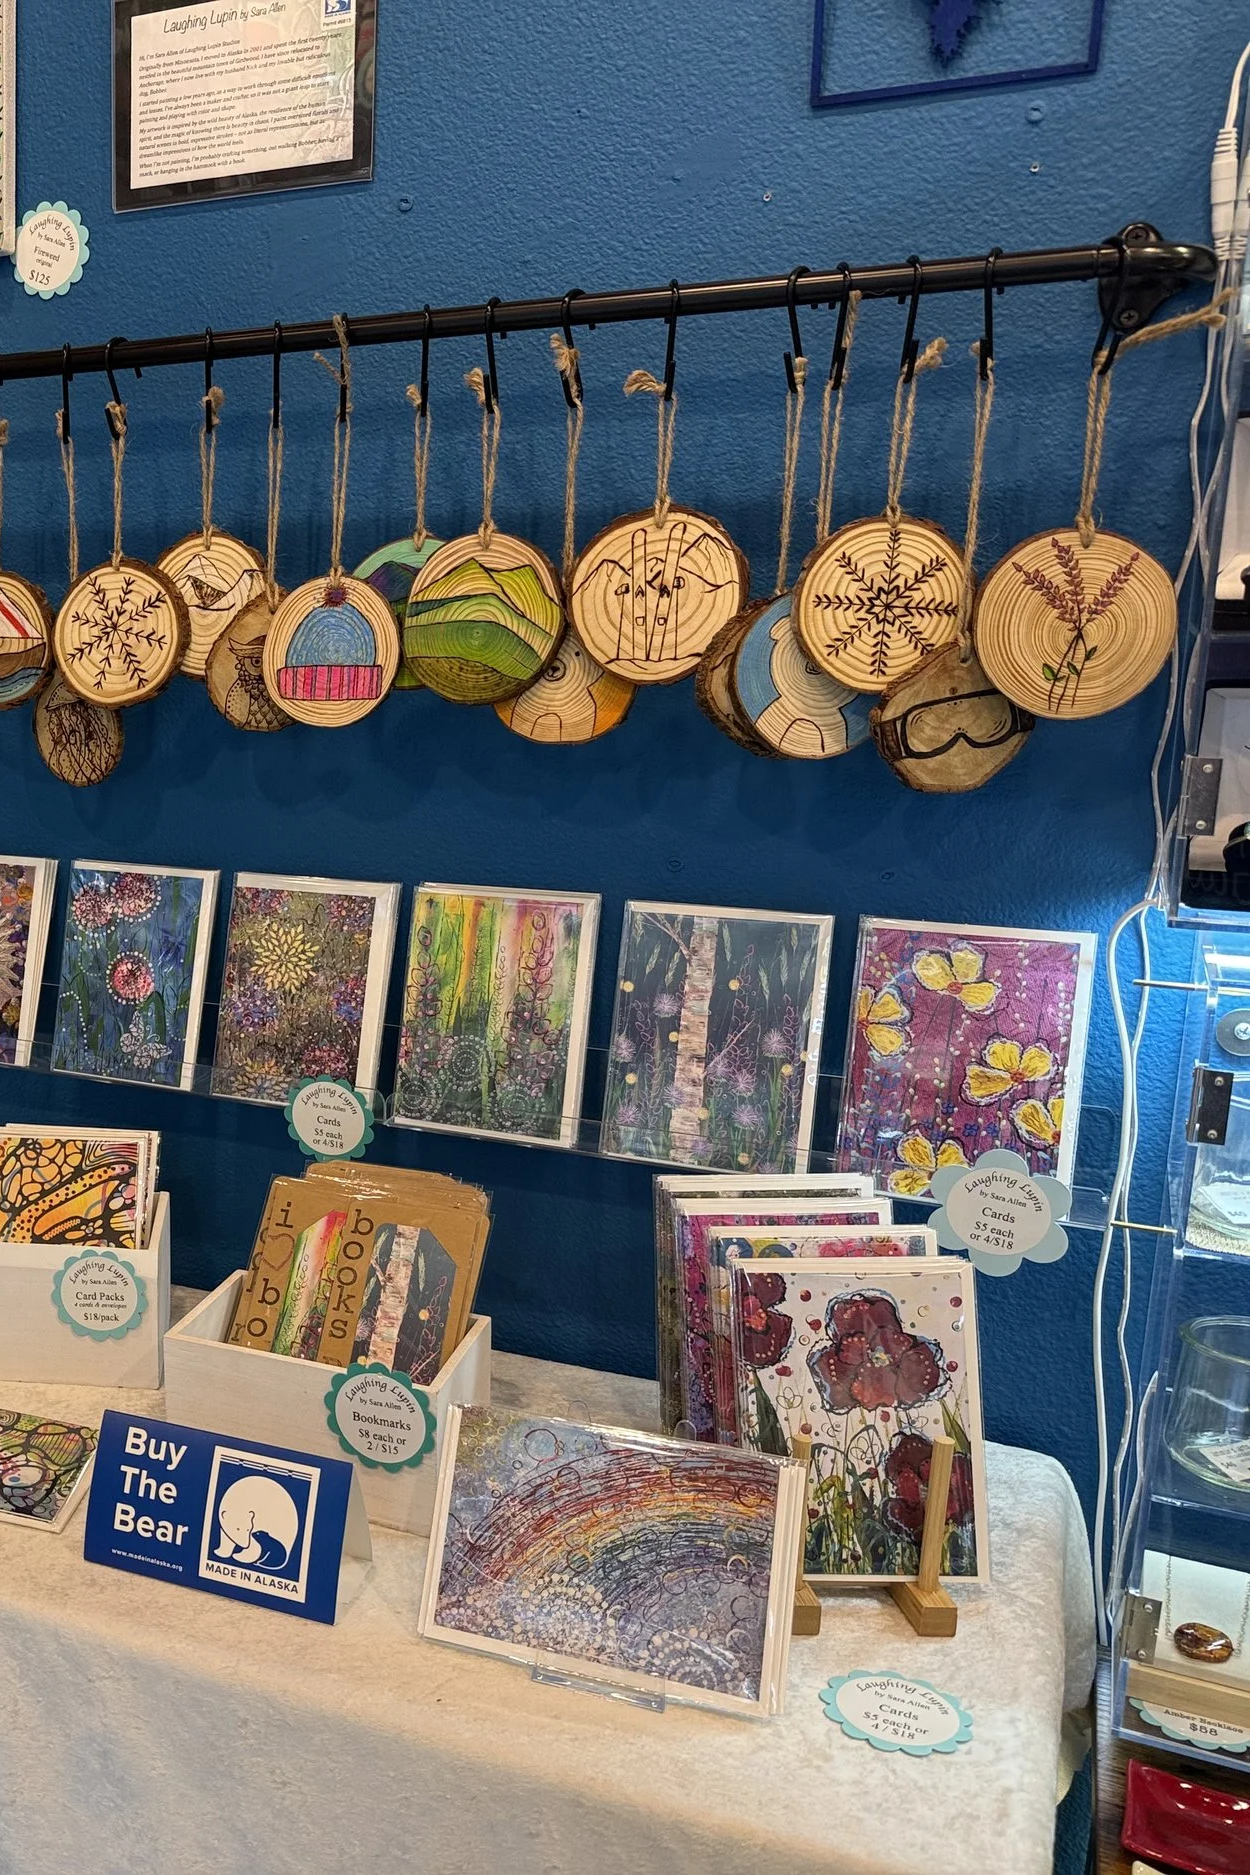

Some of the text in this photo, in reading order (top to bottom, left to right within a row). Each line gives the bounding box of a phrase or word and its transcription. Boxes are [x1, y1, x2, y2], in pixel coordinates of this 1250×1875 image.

[164, 3, 286, 34] Laughing Lupin by Sara Allen
[185, 45, 206, 53] Laughing
[30, 214, 74, 250] Laughing Lupin
[44, 234, 53, 242] Sara
[34, 246, 60, 261] Fireweed
[29, 270, 50, 285] $125
[301, 1084, 357, 1114] Laughing Lupin
[317, 1116, 340, 1127] Cards
[315, 1128, 323, 1136] $5
[322, 1139, 344, 1149] 4/$18
[964, 1171, 1042, 1212] Laughing Lupin
[980, 1190, 1027, 1207] by Sara Allen
[982, 1207, 1015, 1224] Cards
[974, 1221, 1014, 1238] $5 each
[970, 1232, 1013, 1250] or 4/$18
[69, 1261, 129, 1286] Laughing Lupin
[76, 1292, 124, 1301] Card Packs
[84, 1313, 119, 1322] $18/pack
[346, 1376, 415, 1413] Laughing Lupin
[359, 1397, 401, 1410] by Sara Allen
[353, 1411, 411, 1431] Bookmarks
[359, 1429, 406, 1445] $8 each or
[124, 1426, 187, 1471] Buy
[367, 1442, 372, 1450] 2
[382, 1445, 398, 1454] $15
[120, 1465, 177, 1504] The
[113, 1502, 189, 1546] Bear
[111, 1548, 183, 1572] www.madeinalaska.org
[205, 1562, 299, 1594] MADE IN ALASKA
[856, 1679, 948, 1715] Laughing Lupin
[874, 1690, 930, 1710] by Sara Allen
[879, 1703, 918, 1721] Cards
[1164, 1709, 1243, 1733] Amber Necklace
[863, 1711, 929, 1735] $5 each or
[1190, 1723, 1218, 1736] $88
[891, 1728, 915, 1740] $18
